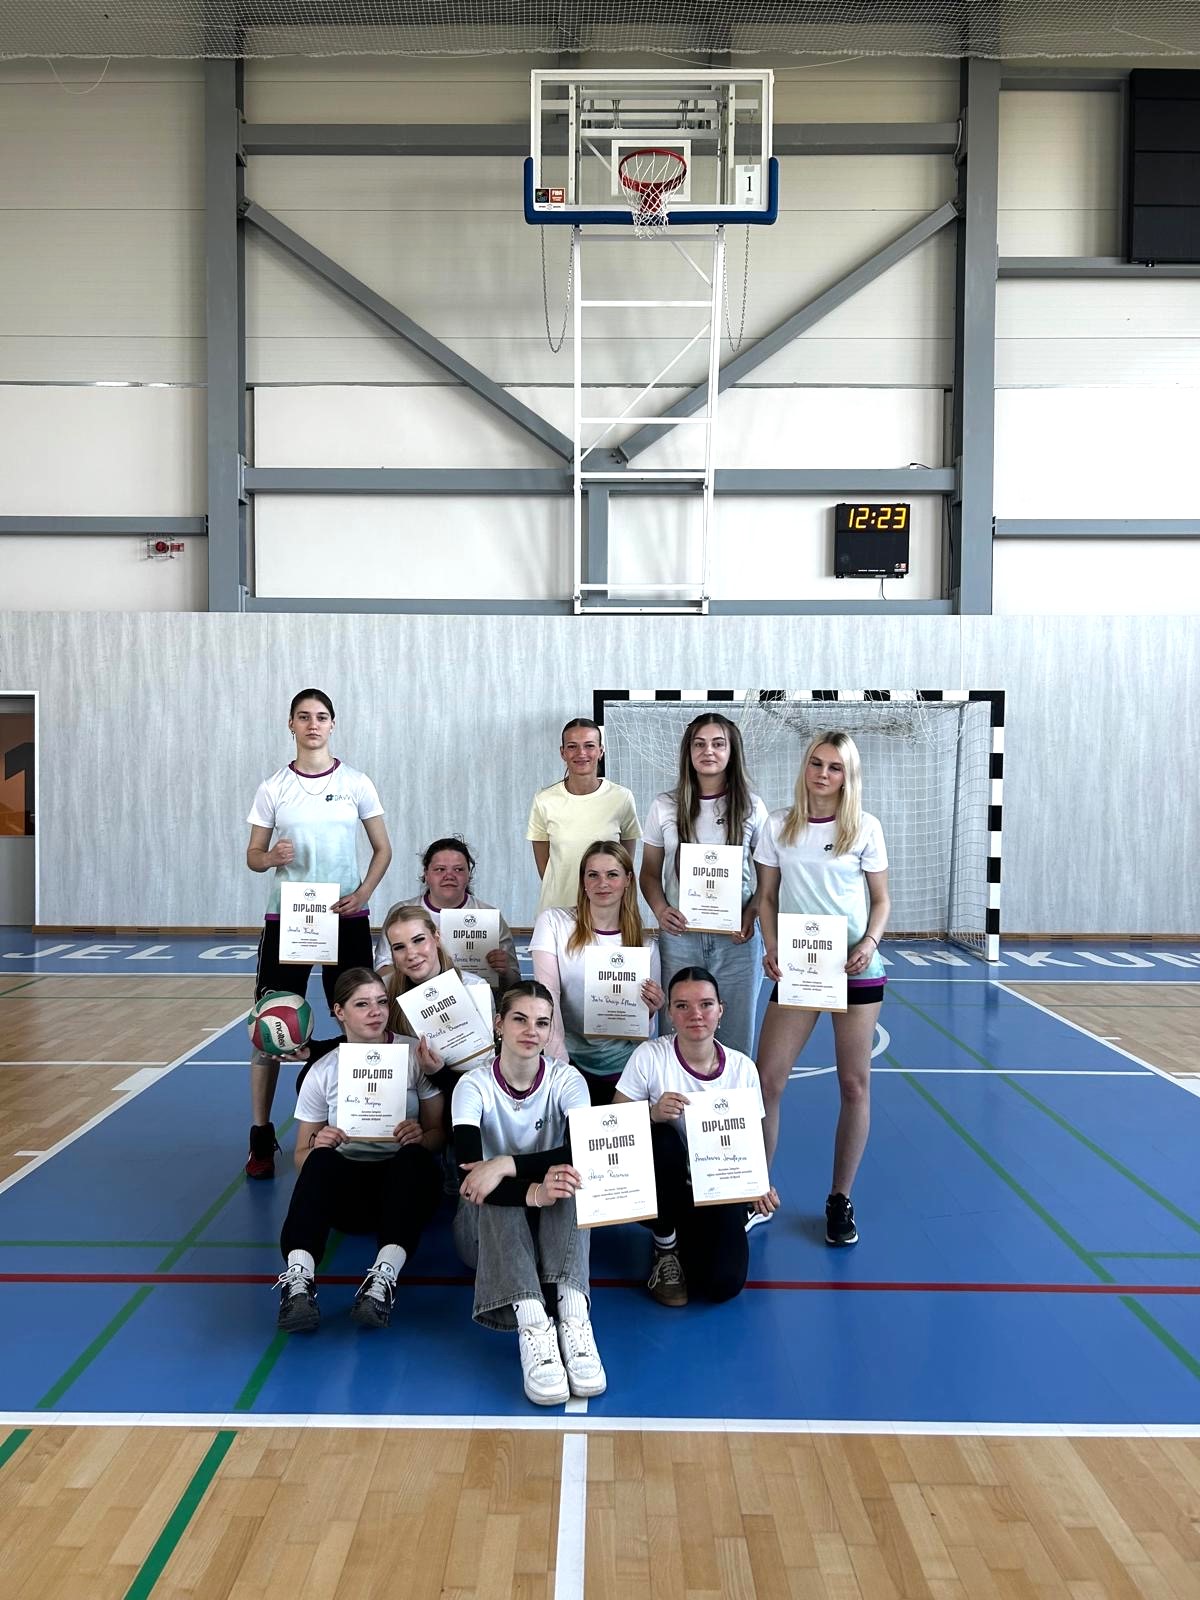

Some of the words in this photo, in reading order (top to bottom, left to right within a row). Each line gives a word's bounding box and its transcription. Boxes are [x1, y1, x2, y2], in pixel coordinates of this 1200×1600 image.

[746, 175, 752, 192] 1
[848, 507, 907, 529] 12:23
[693, 867, 729, 878] DIPLOMS
[706, 879, 715, 889] III
[293, 903, 327, 913] DIPLOMS
[305, 915, 314, 924] III
[453, 930, 487, 939] DIPLOMS
[465, 941, 474, 950] III
[792, 938, 833, 951] DIPLOMS
[807, 953, 817, 964] III
[598, 971, 636, 982] DIPLOMS
[612, 984, 622, 994] III
[420, 995, 457, 1020] DIPLOMS
[439, 1012, 450, 1024] III
[352, 1068, 393, 1079] DIPLOMS
[367, 1082, 377, 1093] III
[701, 1117, 746, 1133] DIPLOMS
[588, 1134, 636, 1152] DIPLOMS
[720, 1135, 731, 1147] III
[607, 1153, 619, 1166] III
